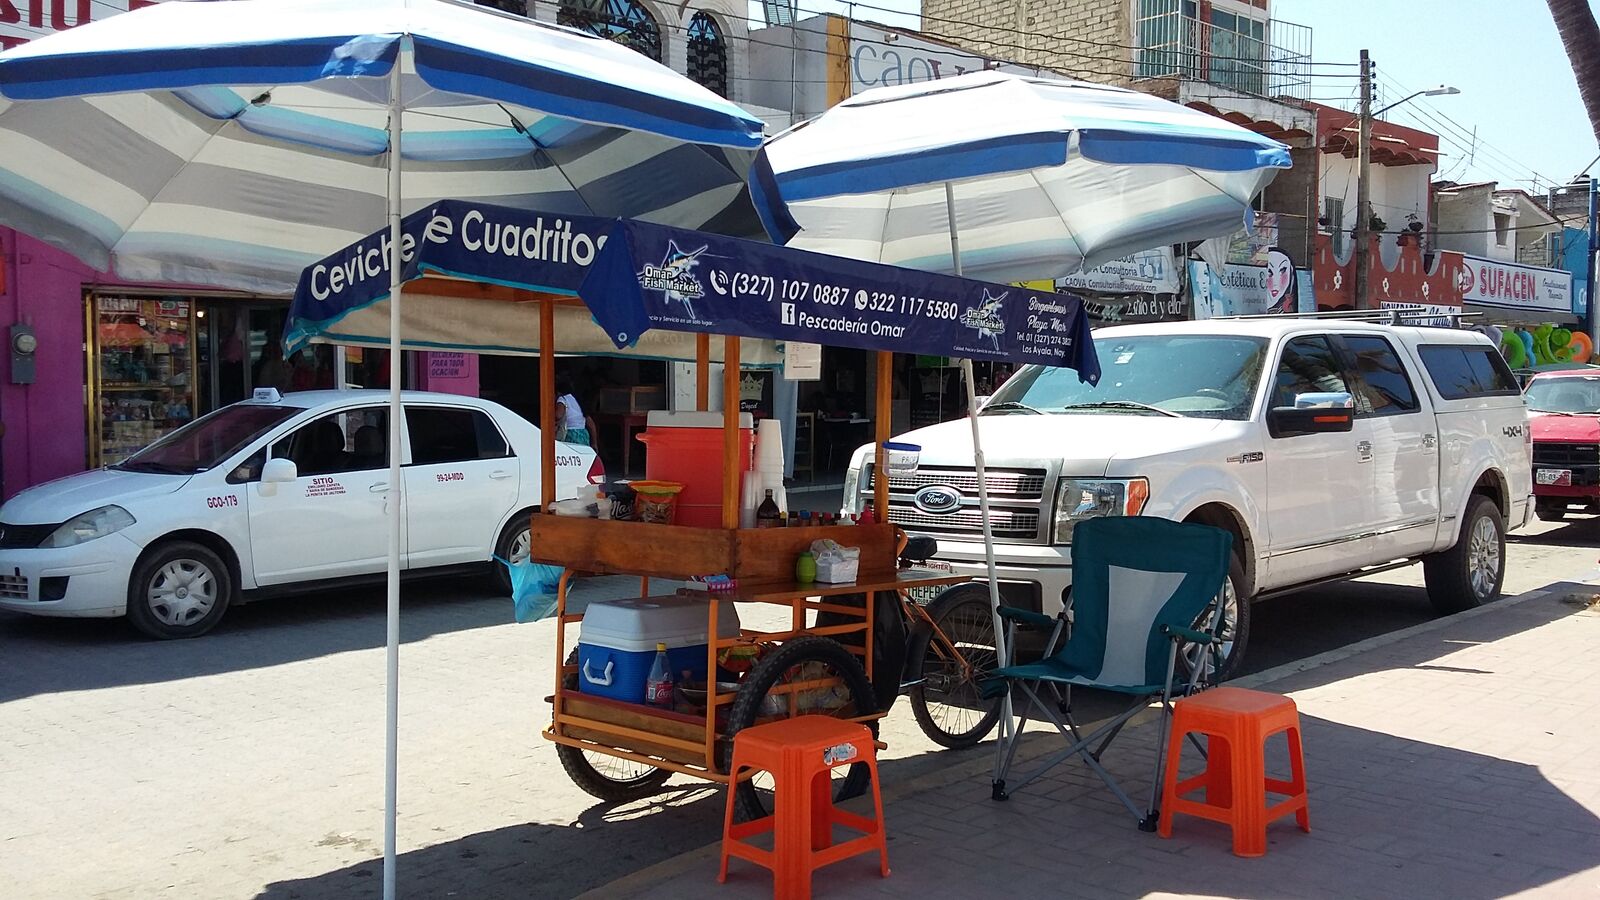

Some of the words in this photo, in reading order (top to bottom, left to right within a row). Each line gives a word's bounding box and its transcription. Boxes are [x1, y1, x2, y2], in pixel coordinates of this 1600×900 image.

[310, 233, 416, 301] Ceviche
[645, 266, 672, 280] Omar
[644, 278, 664, 288] Fish
[666, 280, 699, 292] Market
[1260, 271, 1268, 290] E
[1479, 265, 1536, 303] SUFACEN
[731, 272, 775, 302] (327)
[782, 279, 810, 301] 107
[813, 283, 850, 306] 0887
[869, 292, 896, 312] 322
[900, 296, 925, 316] 117
[926, 300, 958, 321] 5580
[967, 309, 985, 320] Omar
[1159, 301, 1166, 320] y
[799, 311, 868, 334] Pescadería
[870, 320, 906, 338] Omar
[1027, 315, 1048, 333] Playa
[1050, 317, 1067, 333] Mar
[1026, 333, 1033, 342] 01
[1034, 333, 1050, 345] (327)
[1051, 336, 1062, 345] 274
[1022, 345, 1032, 354] Los
[431, 359, 449, 367] PARA
[436, 472, 464, 482] 99-24-MDD
[206, 494, 238, 508] GCO-179
